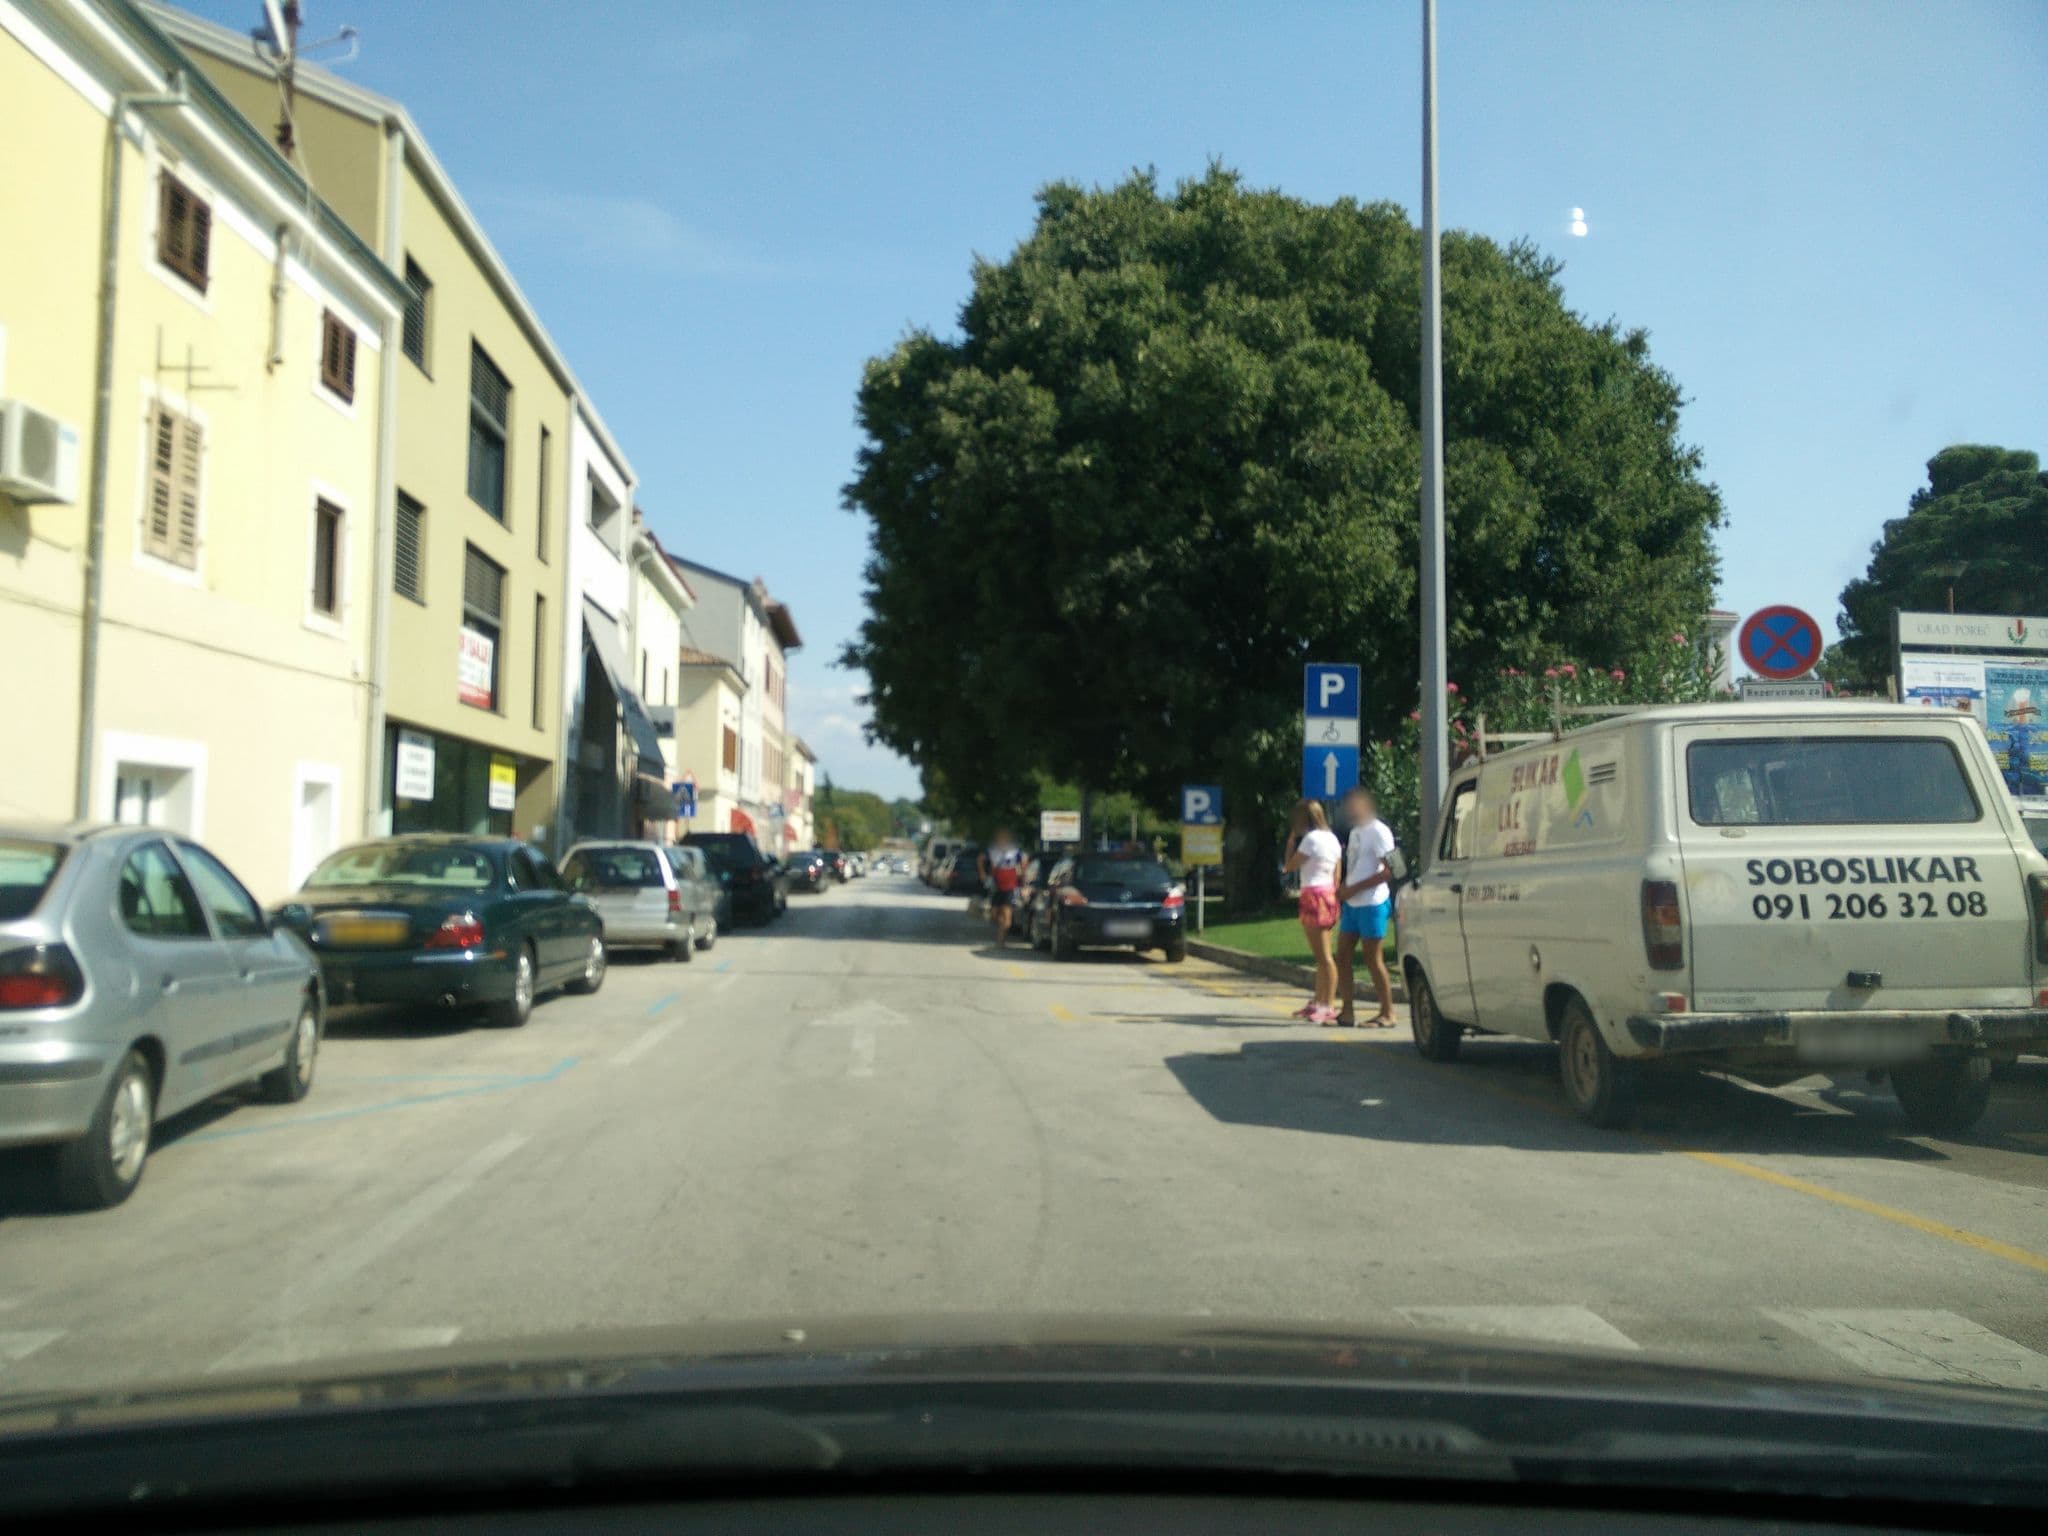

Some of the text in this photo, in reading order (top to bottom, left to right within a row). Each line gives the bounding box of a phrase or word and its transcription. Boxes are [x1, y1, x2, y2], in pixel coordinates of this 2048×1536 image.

[1917, 623, 1950, 634] GRAD
[1320, 673, 1345, 709] P
[1183, 790, 1211, 820] P
[1747, 856, 1983, 886] SOBOSLIKAR
[1752, 891, 1988, 920] 091 206 32 08
